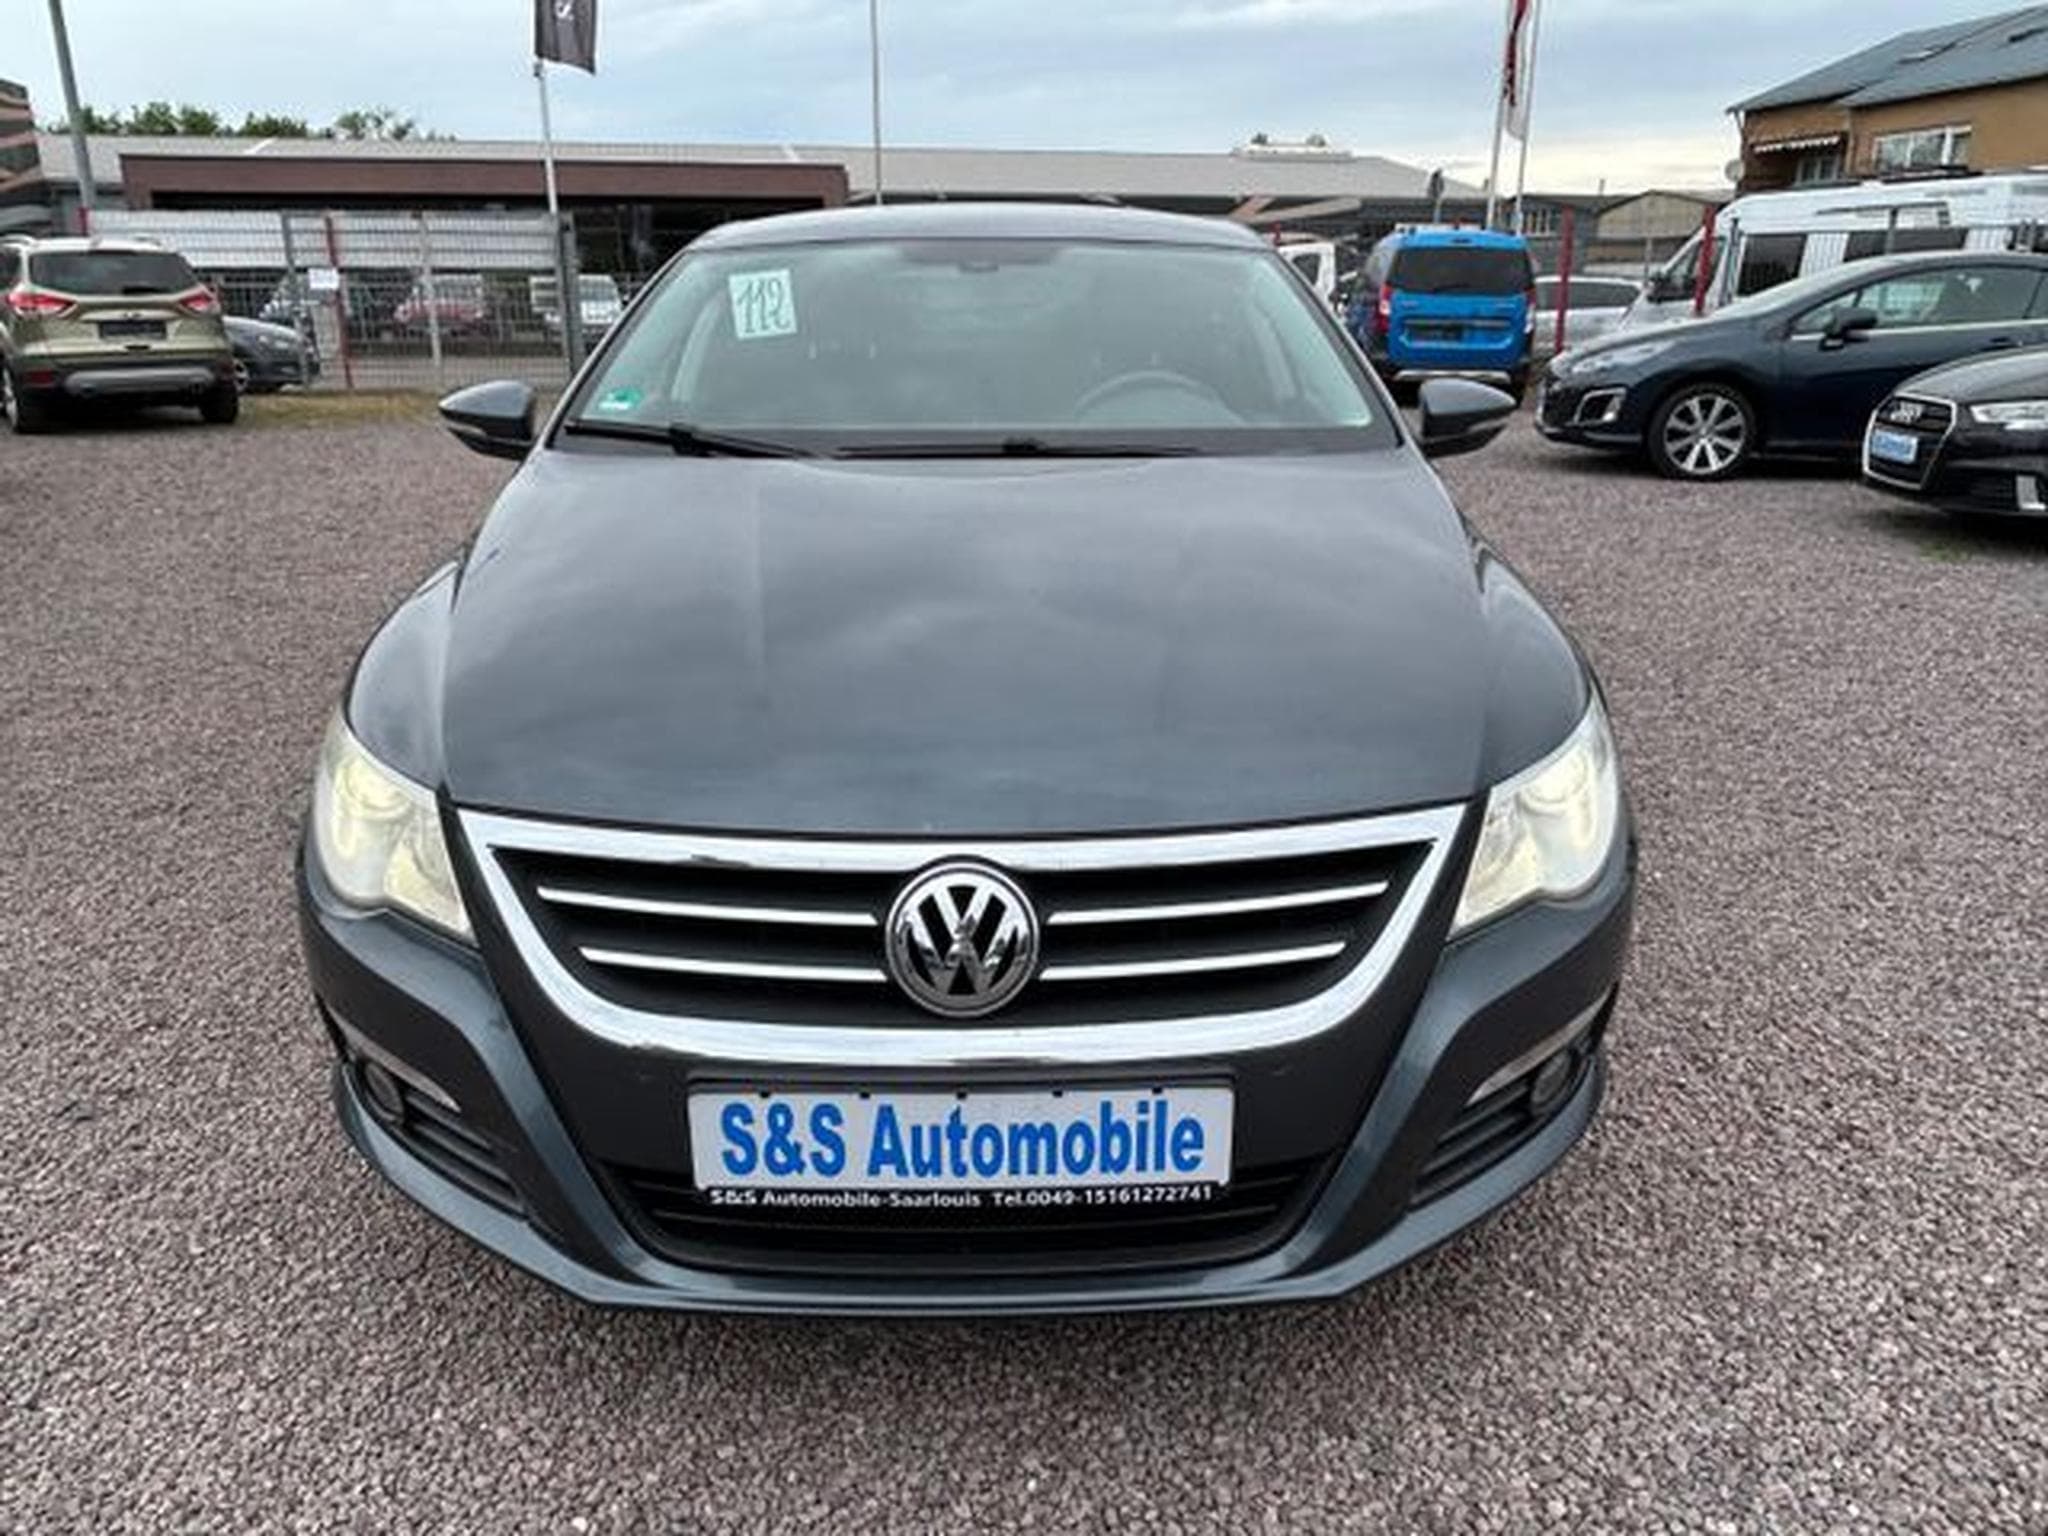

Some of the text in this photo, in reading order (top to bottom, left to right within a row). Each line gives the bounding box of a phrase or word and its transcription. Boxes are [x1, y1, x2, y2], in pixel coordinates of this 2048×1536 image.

[721, 1099, 1204, 1178] S&S Automobile
[710, 1189, 757, 1205] S&S
